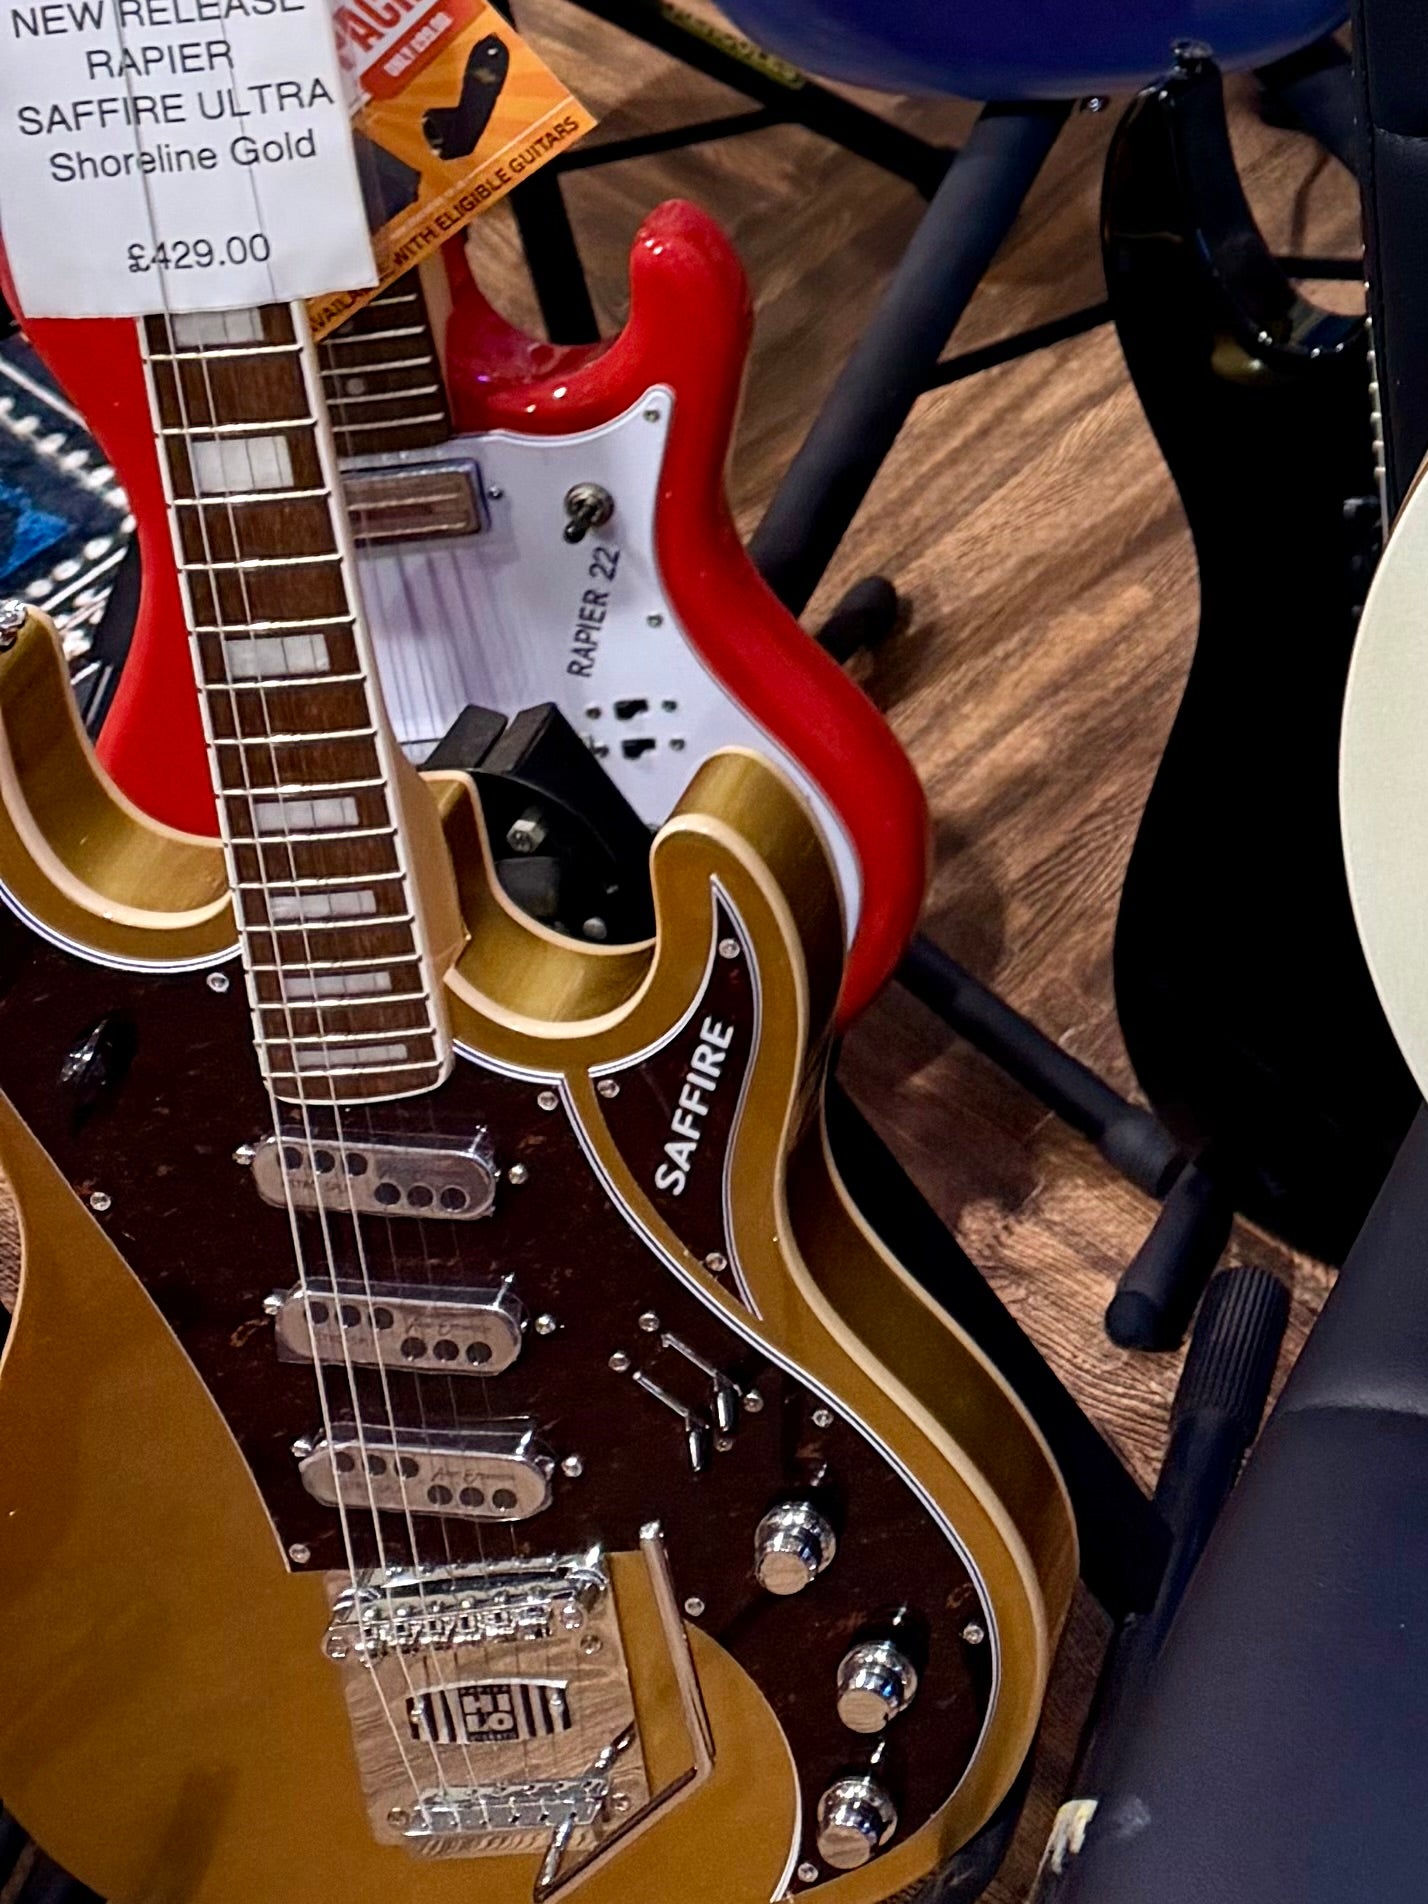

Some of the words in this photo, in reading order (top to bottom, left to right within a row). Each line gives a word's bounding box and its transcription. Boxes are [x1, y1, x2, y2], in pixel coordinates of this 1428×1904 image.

[11, 0, 105, 39] NEW
[86, 39, 235, 80] RAPIER
[17, 90, 187, 137] SAFFIRE
[199, 77, 335, 121] ULTRA
[49, 140, 219, 183] Shoreline
[230, 128, 317, 167] Gold
[436, 167, 512, 233] ELIGIBLE
[508, 115, 579, 174] GUITARS
[127, 233, 271, 273] £429.00
[566, 589, 611, 678] RAPIER
[589, 546, 621, 581] 22
[654, 1015, 734, 1196] SAFFIRE
[461, 1692, 511, 1714] HI
[465, 1712, 514, 1733] LO
